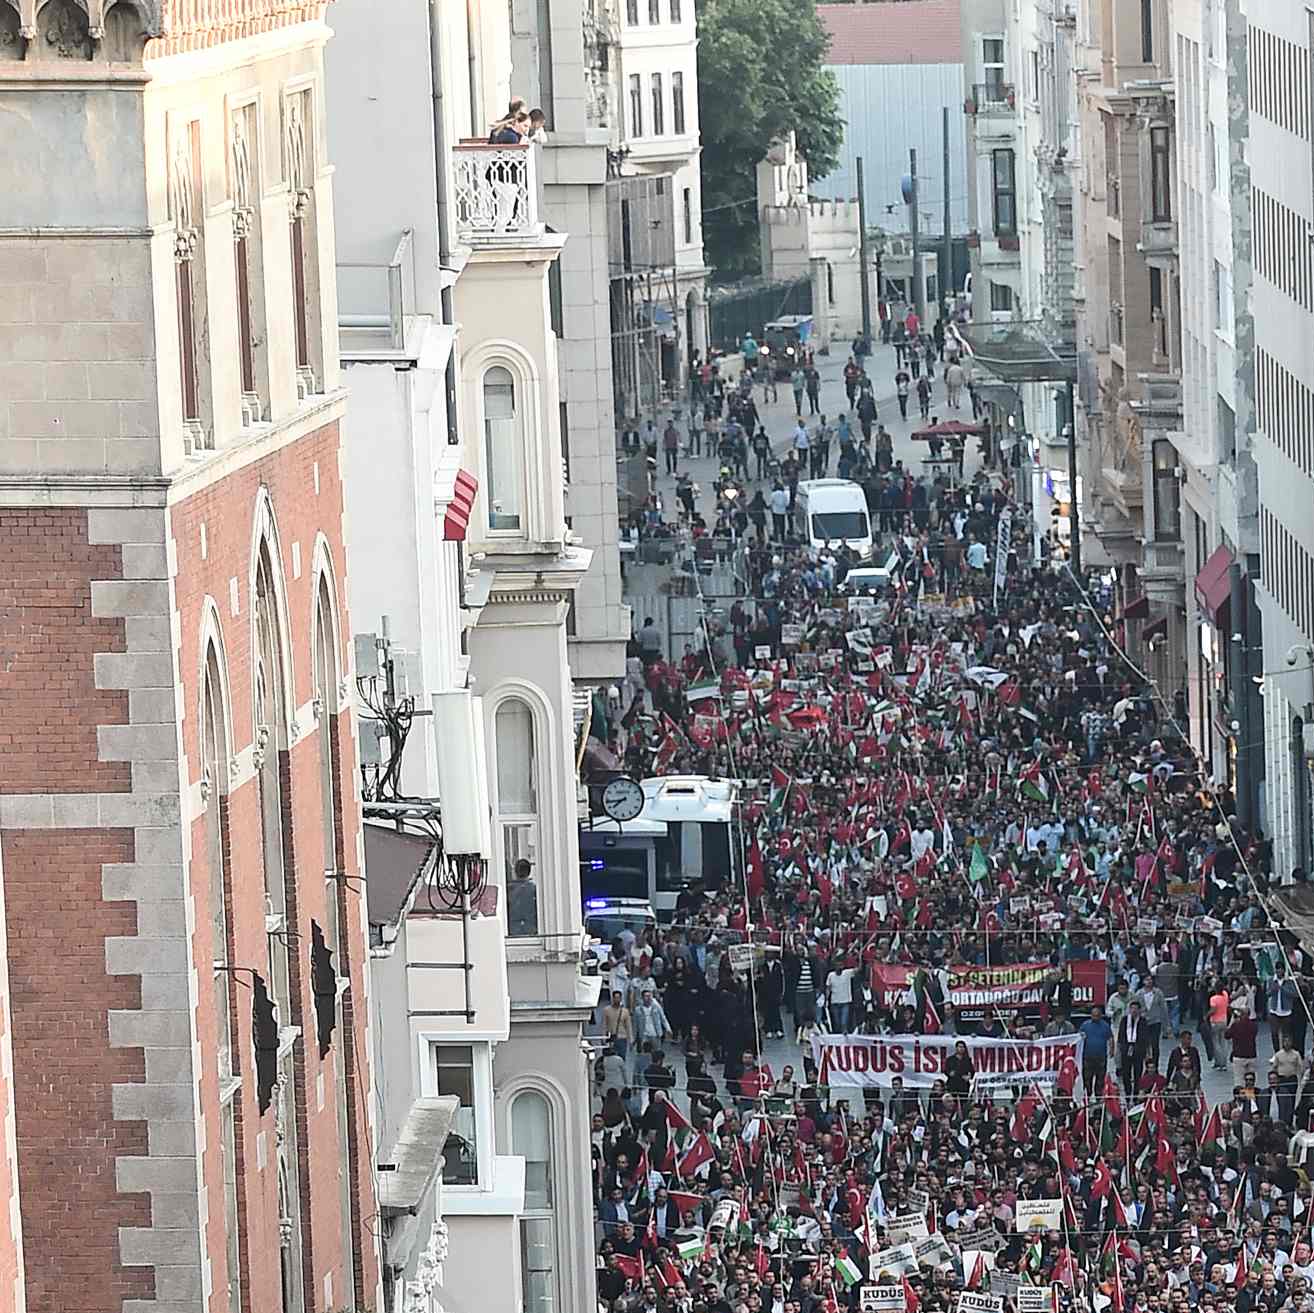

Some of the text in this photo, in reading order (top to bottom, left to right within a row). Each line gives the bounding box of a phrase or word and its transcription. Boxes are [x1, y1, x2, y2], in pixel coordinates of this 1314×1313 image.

[820, 1039, 904, 1073] KUDÜS
[863, 1286, 904, 1299] KUDÜS
[960, 1294, 1001, 1310] KUDÜS
